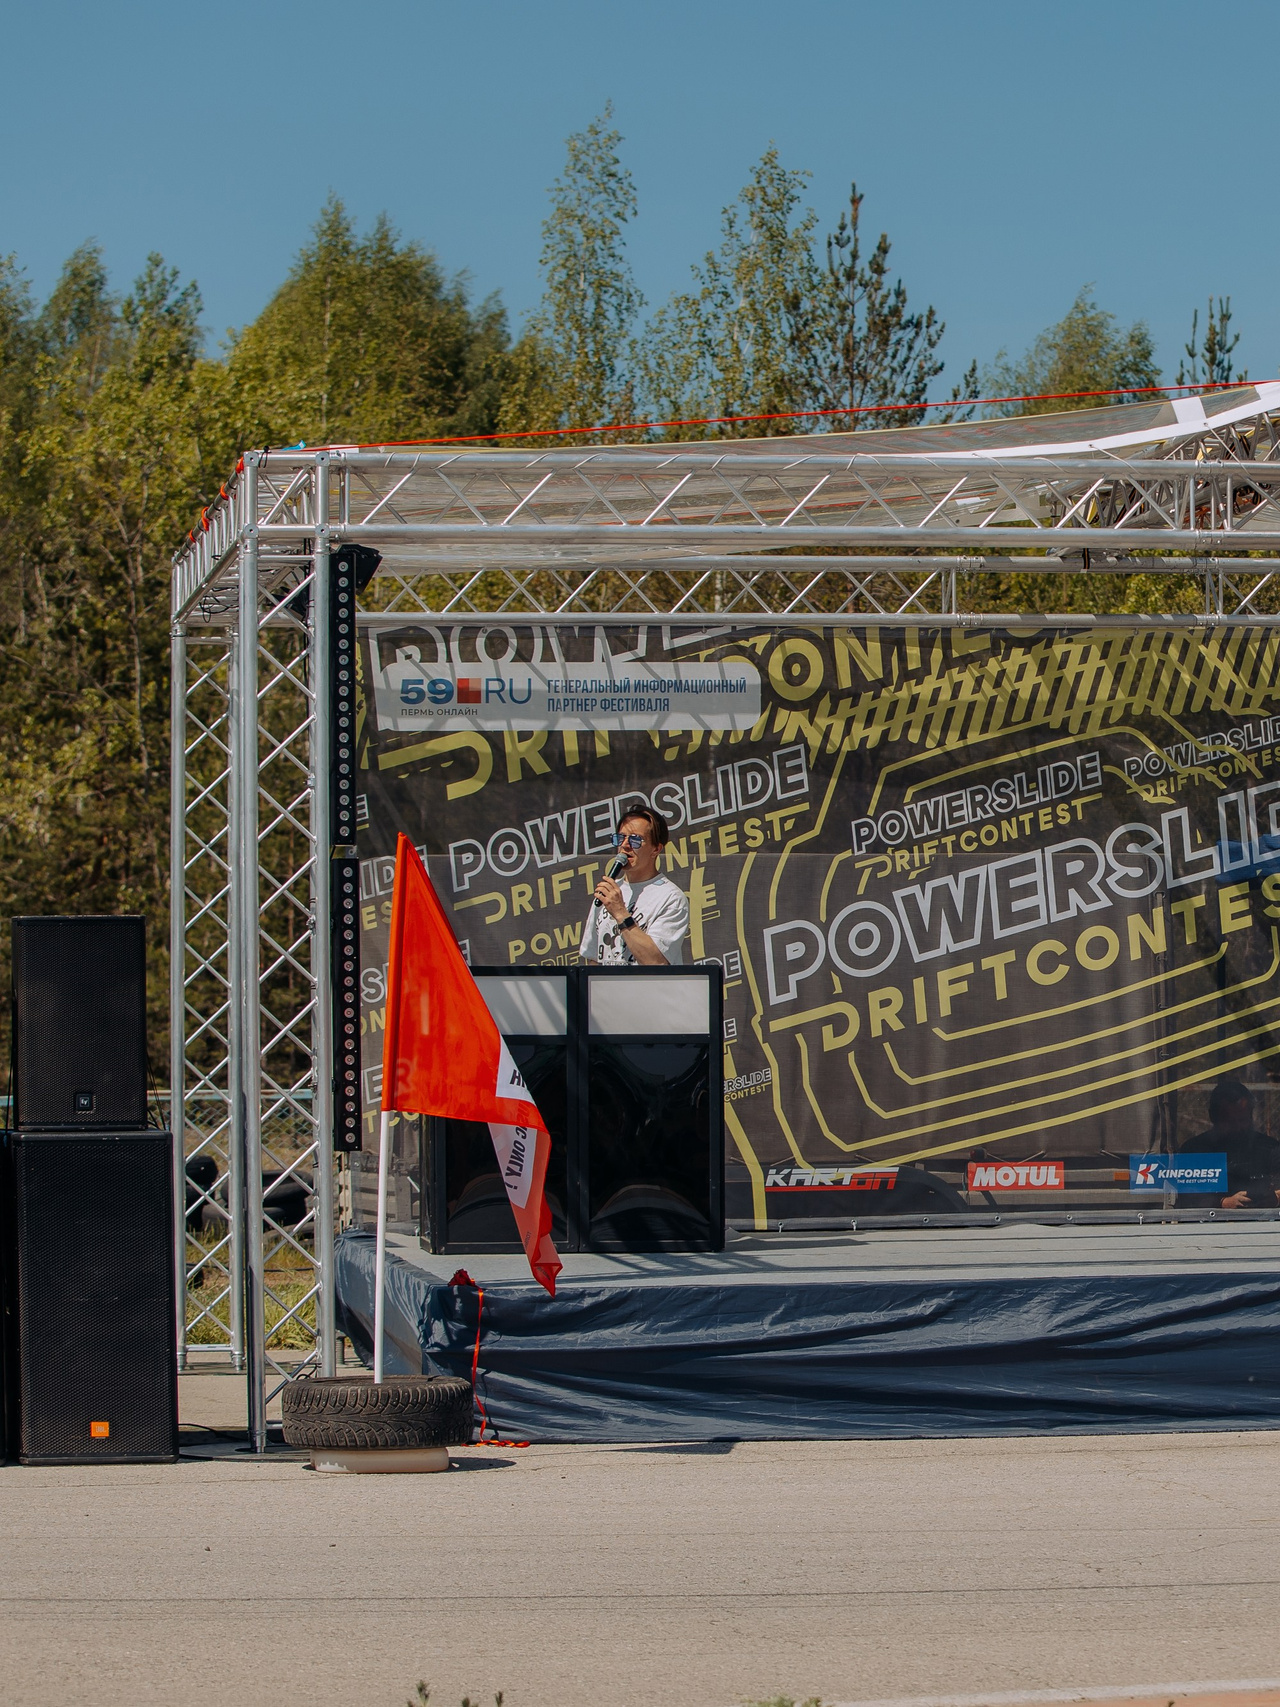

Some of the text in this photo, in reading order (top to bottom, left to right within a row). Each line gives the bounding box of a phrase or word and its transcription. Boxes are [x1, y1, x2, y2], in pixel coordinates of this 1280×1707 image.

[400, 678, 454, 705] 59
[547, 677, 747, 694] ГЕНЕРАЛЬНЫЙ ИНФОРМАЦИОННЫЙ
[401, 707, 478, 716] ПЕРМЬ ОНЛАЙН
[547, 698, 670, 712] ПАРТНЕР ФЕСТИВАЛЯ
[851, 751, 1102, 856] POWERSLIDE
[855, 793, 1102, 879] DRIFTCONTEST
[972, 1166, 1060, 1187] MOTUL
[1158, 1169, 1222, 1179] KINFOREST
